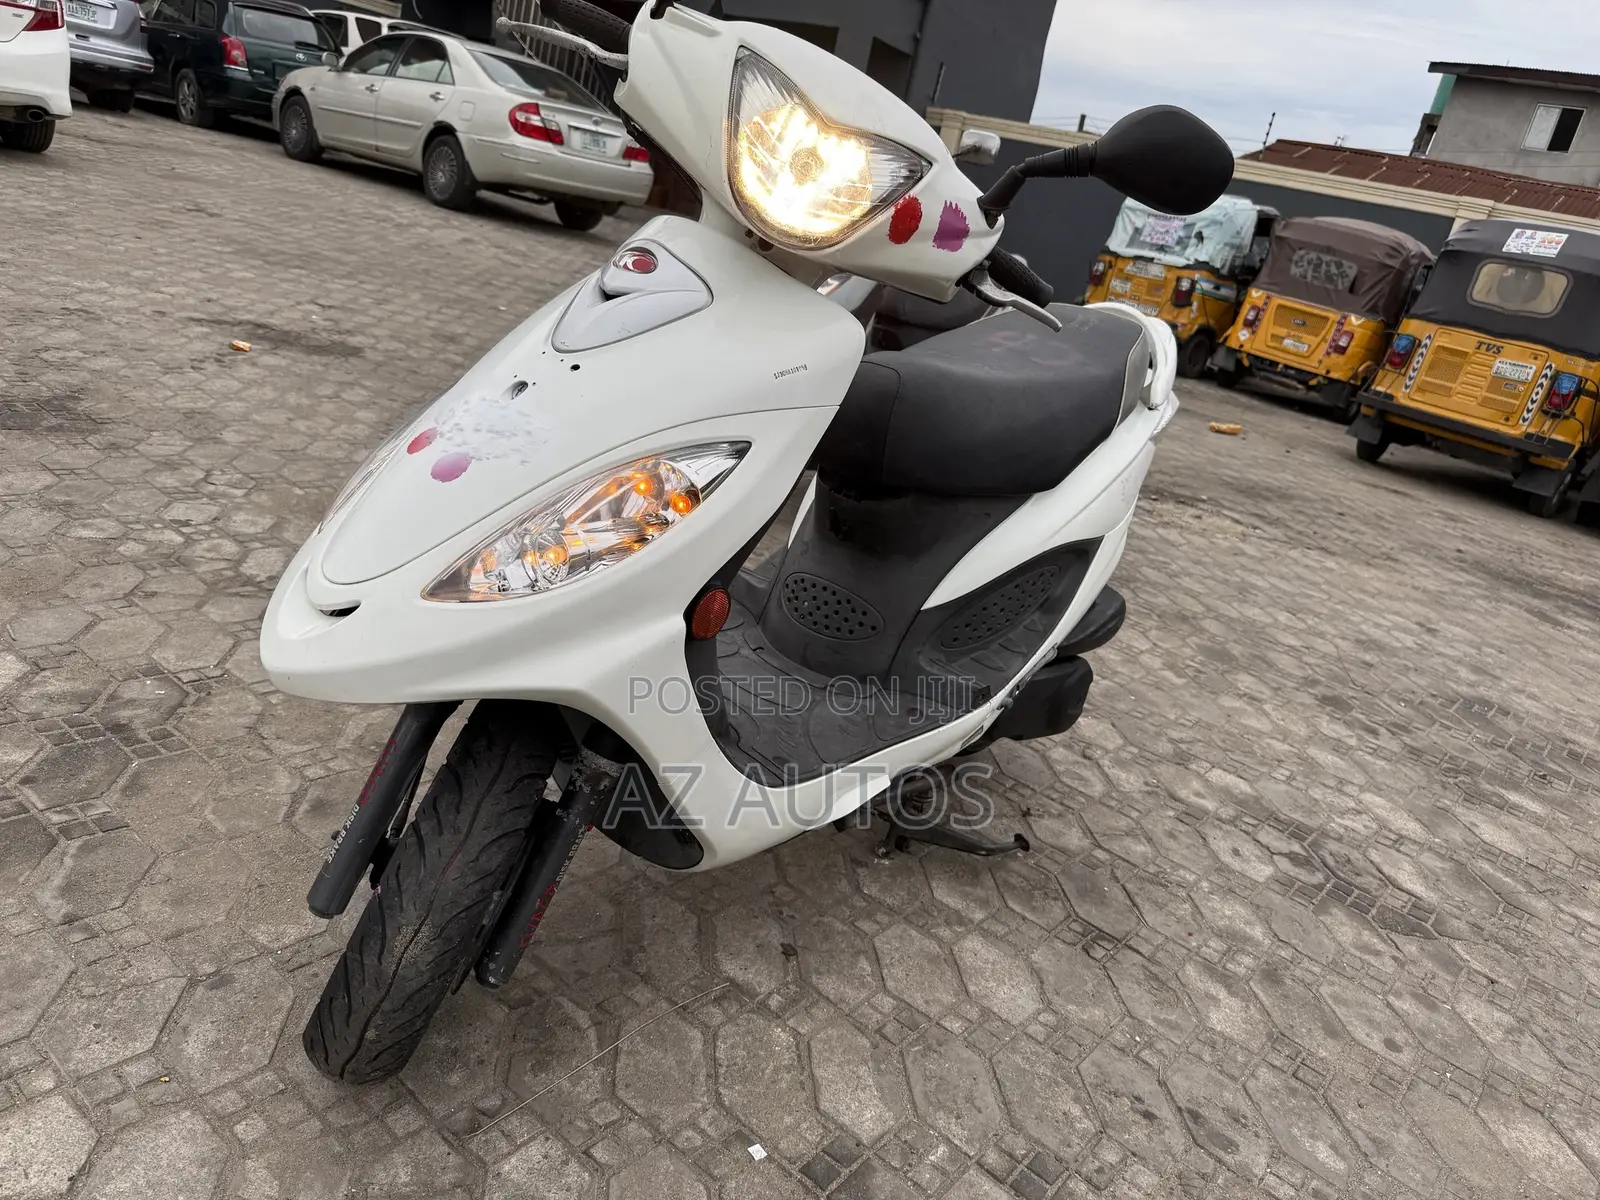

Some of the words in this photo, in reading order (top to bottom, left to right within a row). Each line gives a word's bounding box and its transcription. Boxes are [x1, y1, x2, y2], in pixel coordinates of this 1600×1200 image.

[1475, 340, 1504, 354] TVS
[343, 803, 361, 829] DISK
[327, 828, 347, 864] BRAKE
